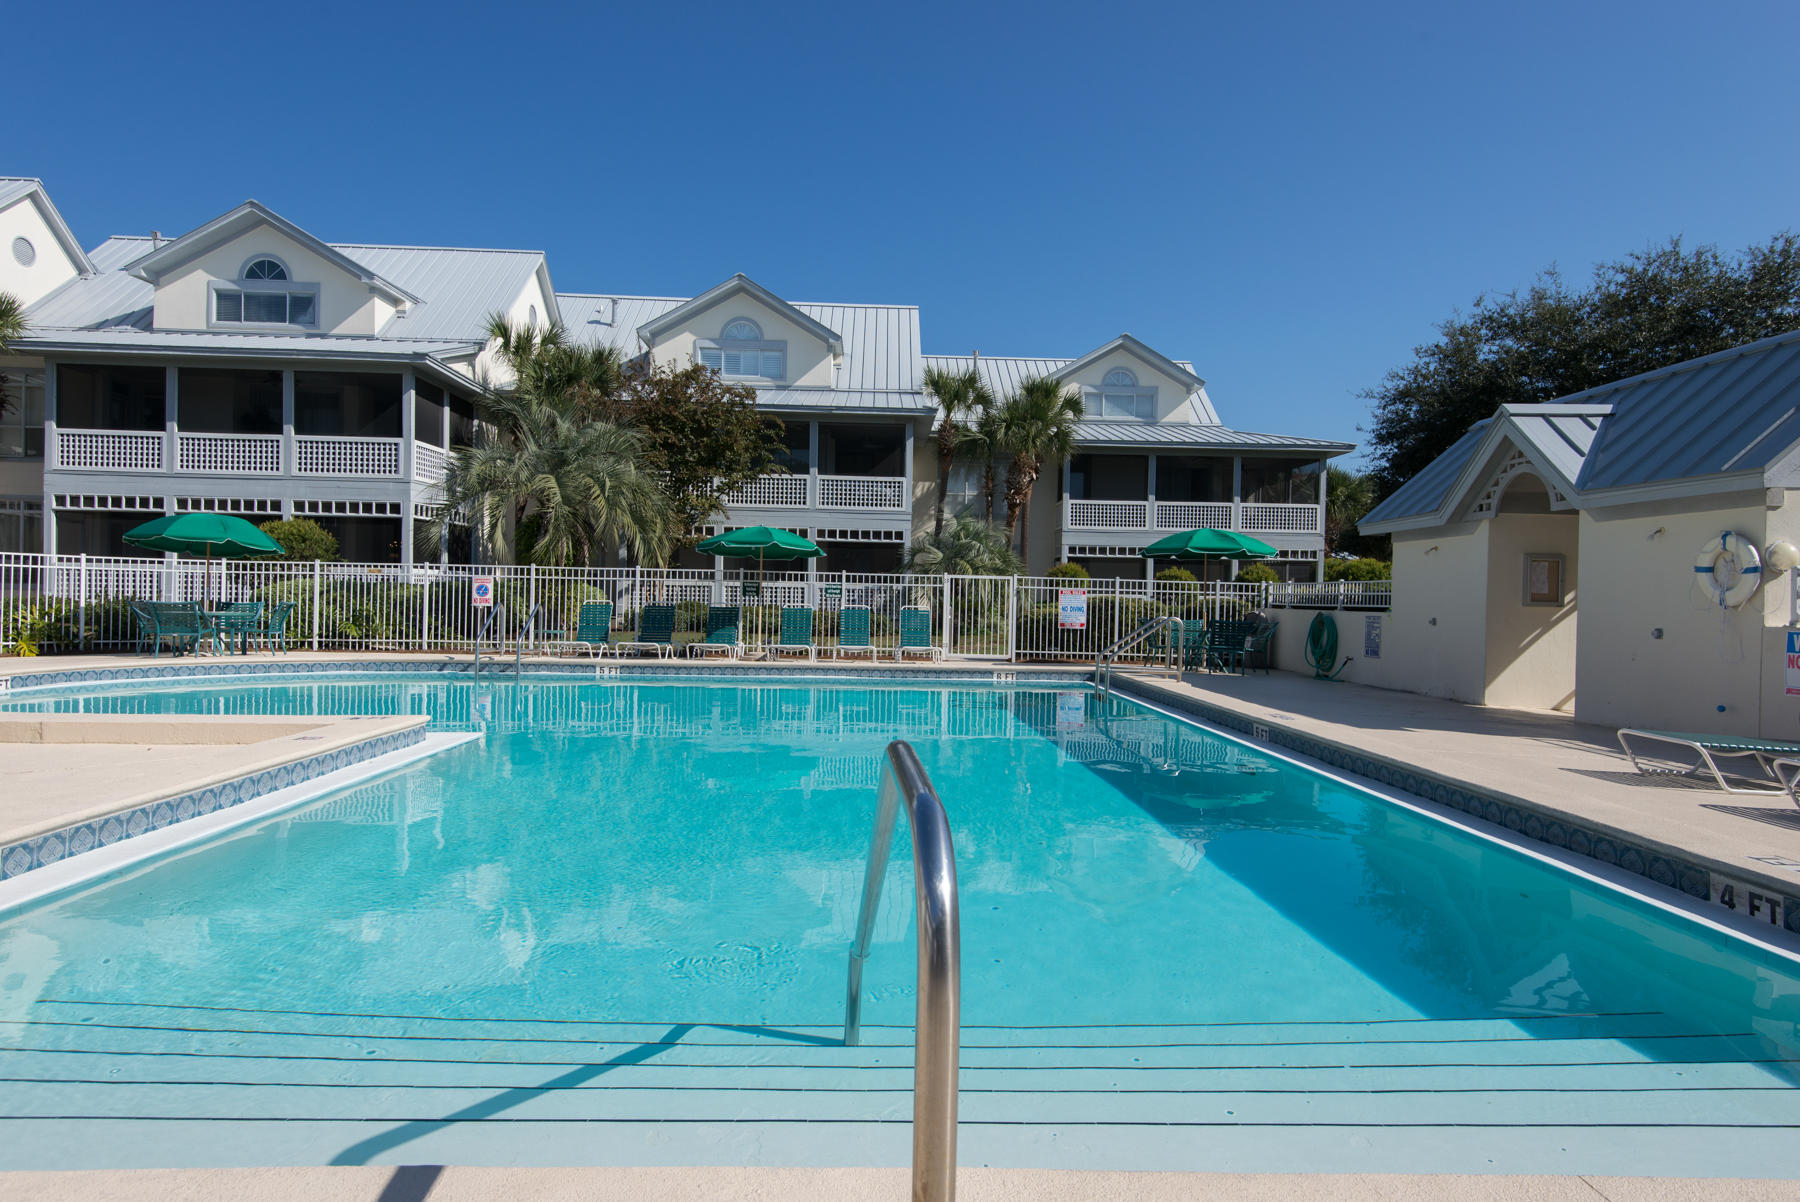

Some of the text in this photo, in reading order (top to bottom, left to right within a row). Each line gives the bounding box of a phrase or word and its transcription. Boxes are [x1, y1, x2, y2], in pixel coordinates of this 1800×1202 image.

[1070, 605, 1084, 613] DIVING
[599, 666, 619, 675] 5 FT
[1005, 672, 1016, 681] FT
[1255, 726, 1268, 742] 5 FT
[1720, 884, 1781, 925] 4 FT
